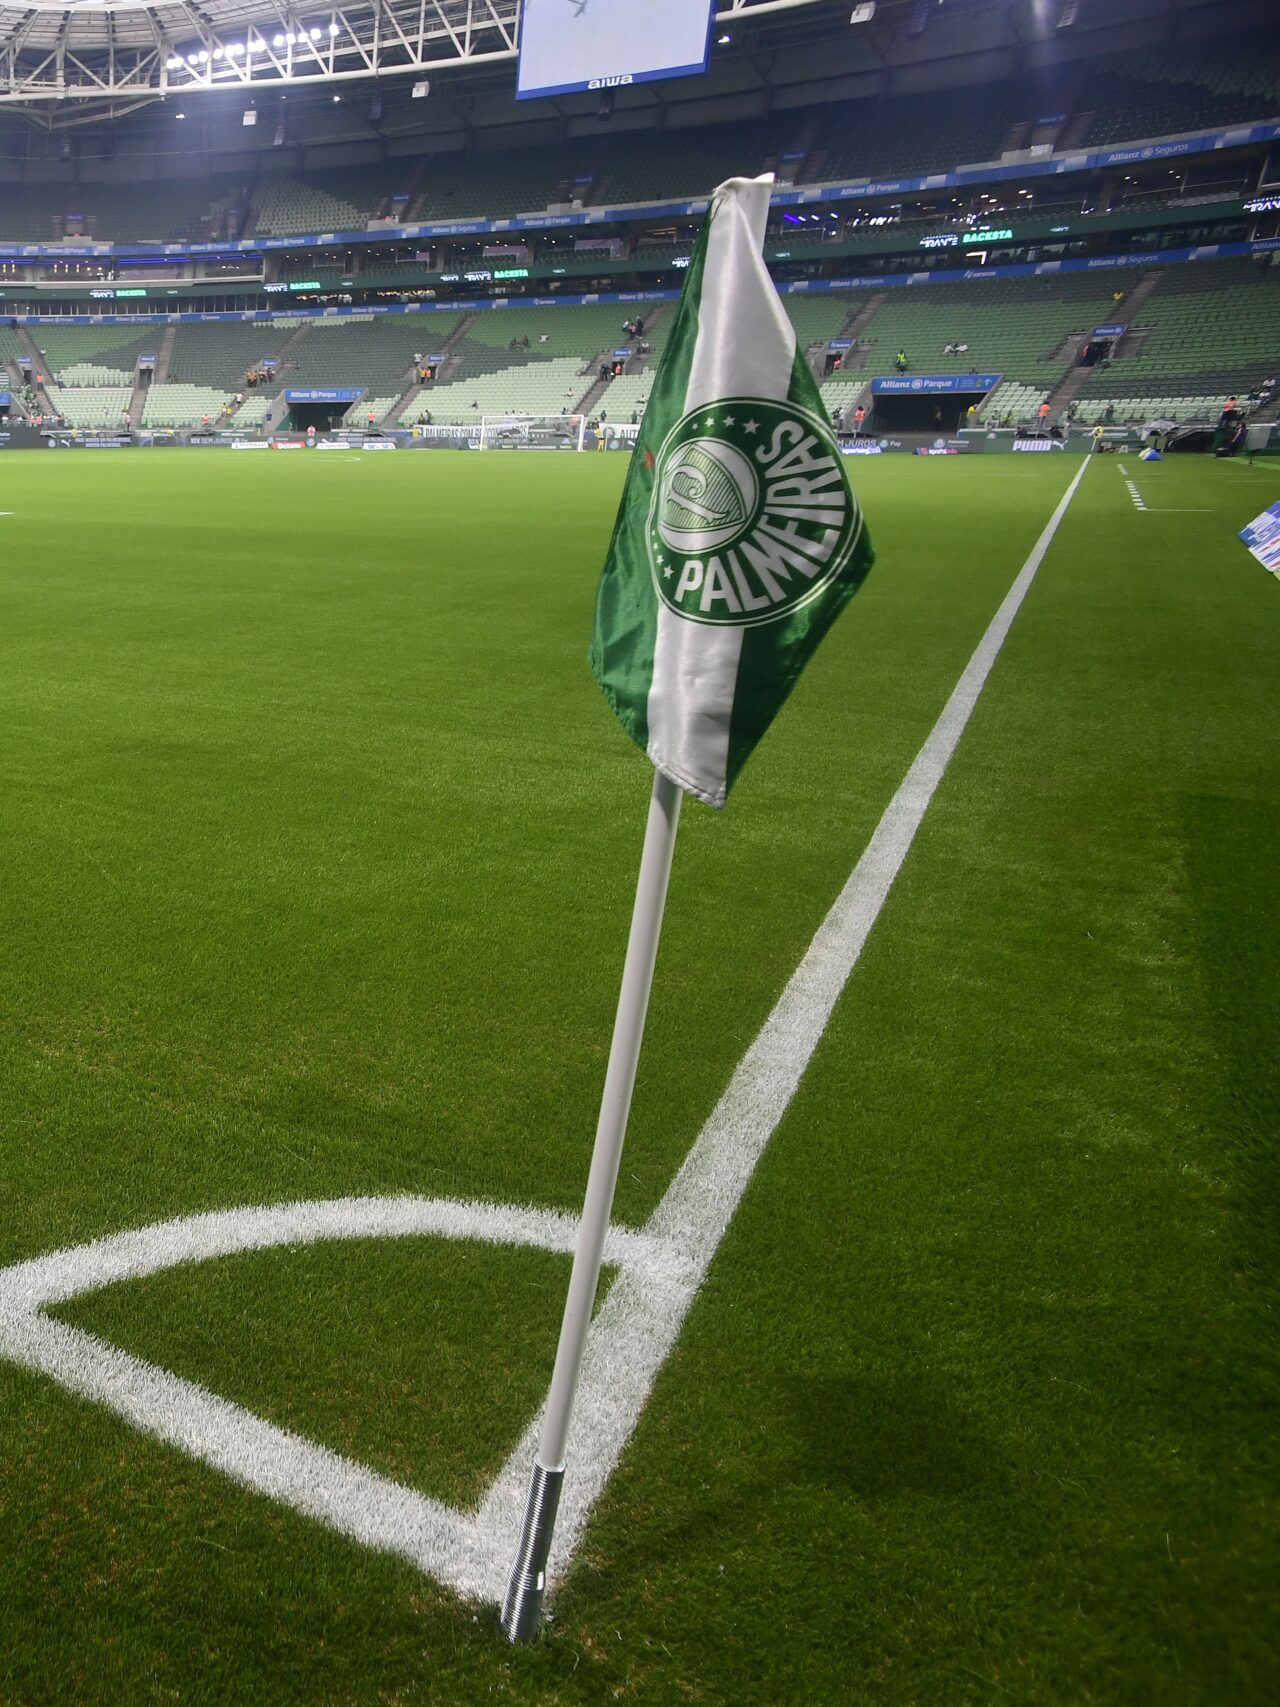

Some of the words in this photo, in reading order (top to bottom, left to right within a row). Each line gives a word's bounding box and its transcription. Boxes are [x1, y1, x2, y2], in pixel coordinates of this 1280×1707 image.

[588, 74, 633, 90] aiwa
[1109, 150, 1140, 162] Allianz
[1154, 144, 1188, 156] Seguros
[840, 186, 866, 196] Allianz
[876, 182, 900, 194] Parque
[962, 230, 1012, 243] BACKSTA
[1088, 258, 1116, 267] Allianz
[1128, 254, 1158, 264] Seguros
[494, 269, 528, 278] BACKSTA
[290, 282, 321, 290] BACKSTA
[880, 379, 910, 389] Allianz
[924, 378, 952, 390] Parque
[318, 390, 336, 399] Parque
[846, 440, 876, 448] JUROS
[1013, 440, 1052, 451] PUMA
[675, 421, 846, 612] PALMEIRAS
